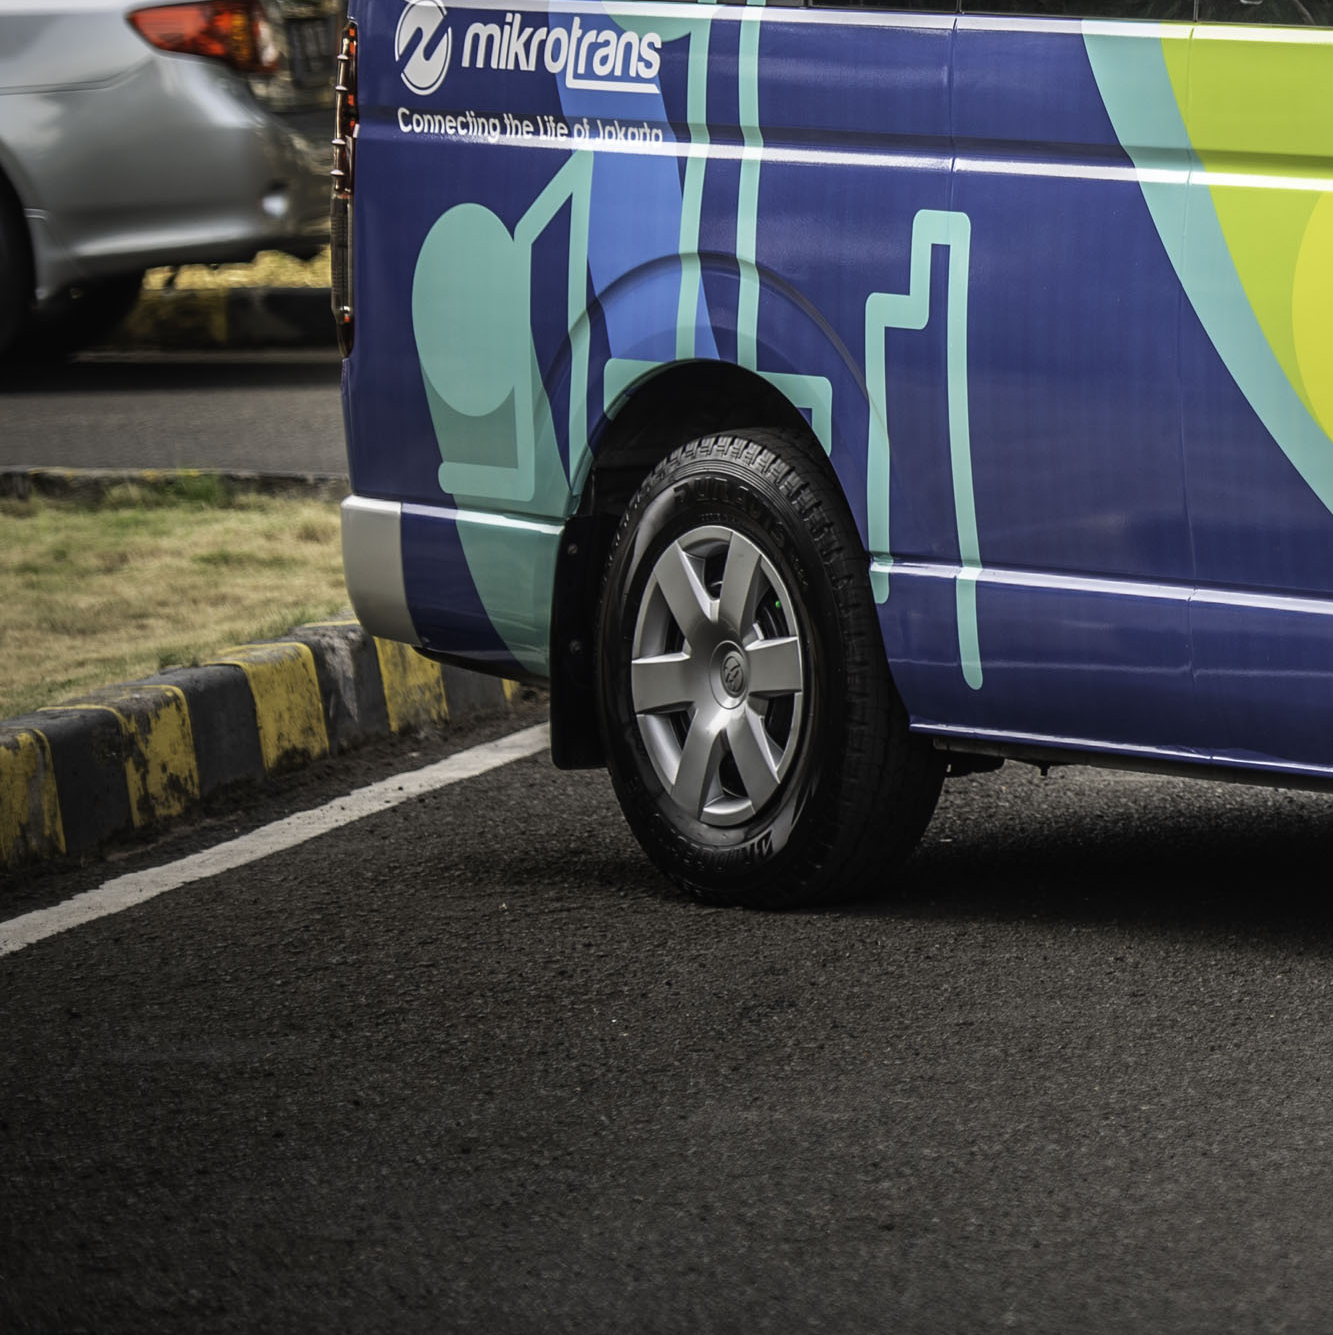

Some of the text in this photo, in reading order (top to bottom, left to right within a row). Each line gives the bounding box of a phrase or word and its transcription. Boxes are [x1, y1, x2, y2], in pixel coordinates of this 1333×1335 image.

[461, 12, 663, 94] mikrotrans
[397, 106, 663, 148] Connecting the Life of Jakarta
